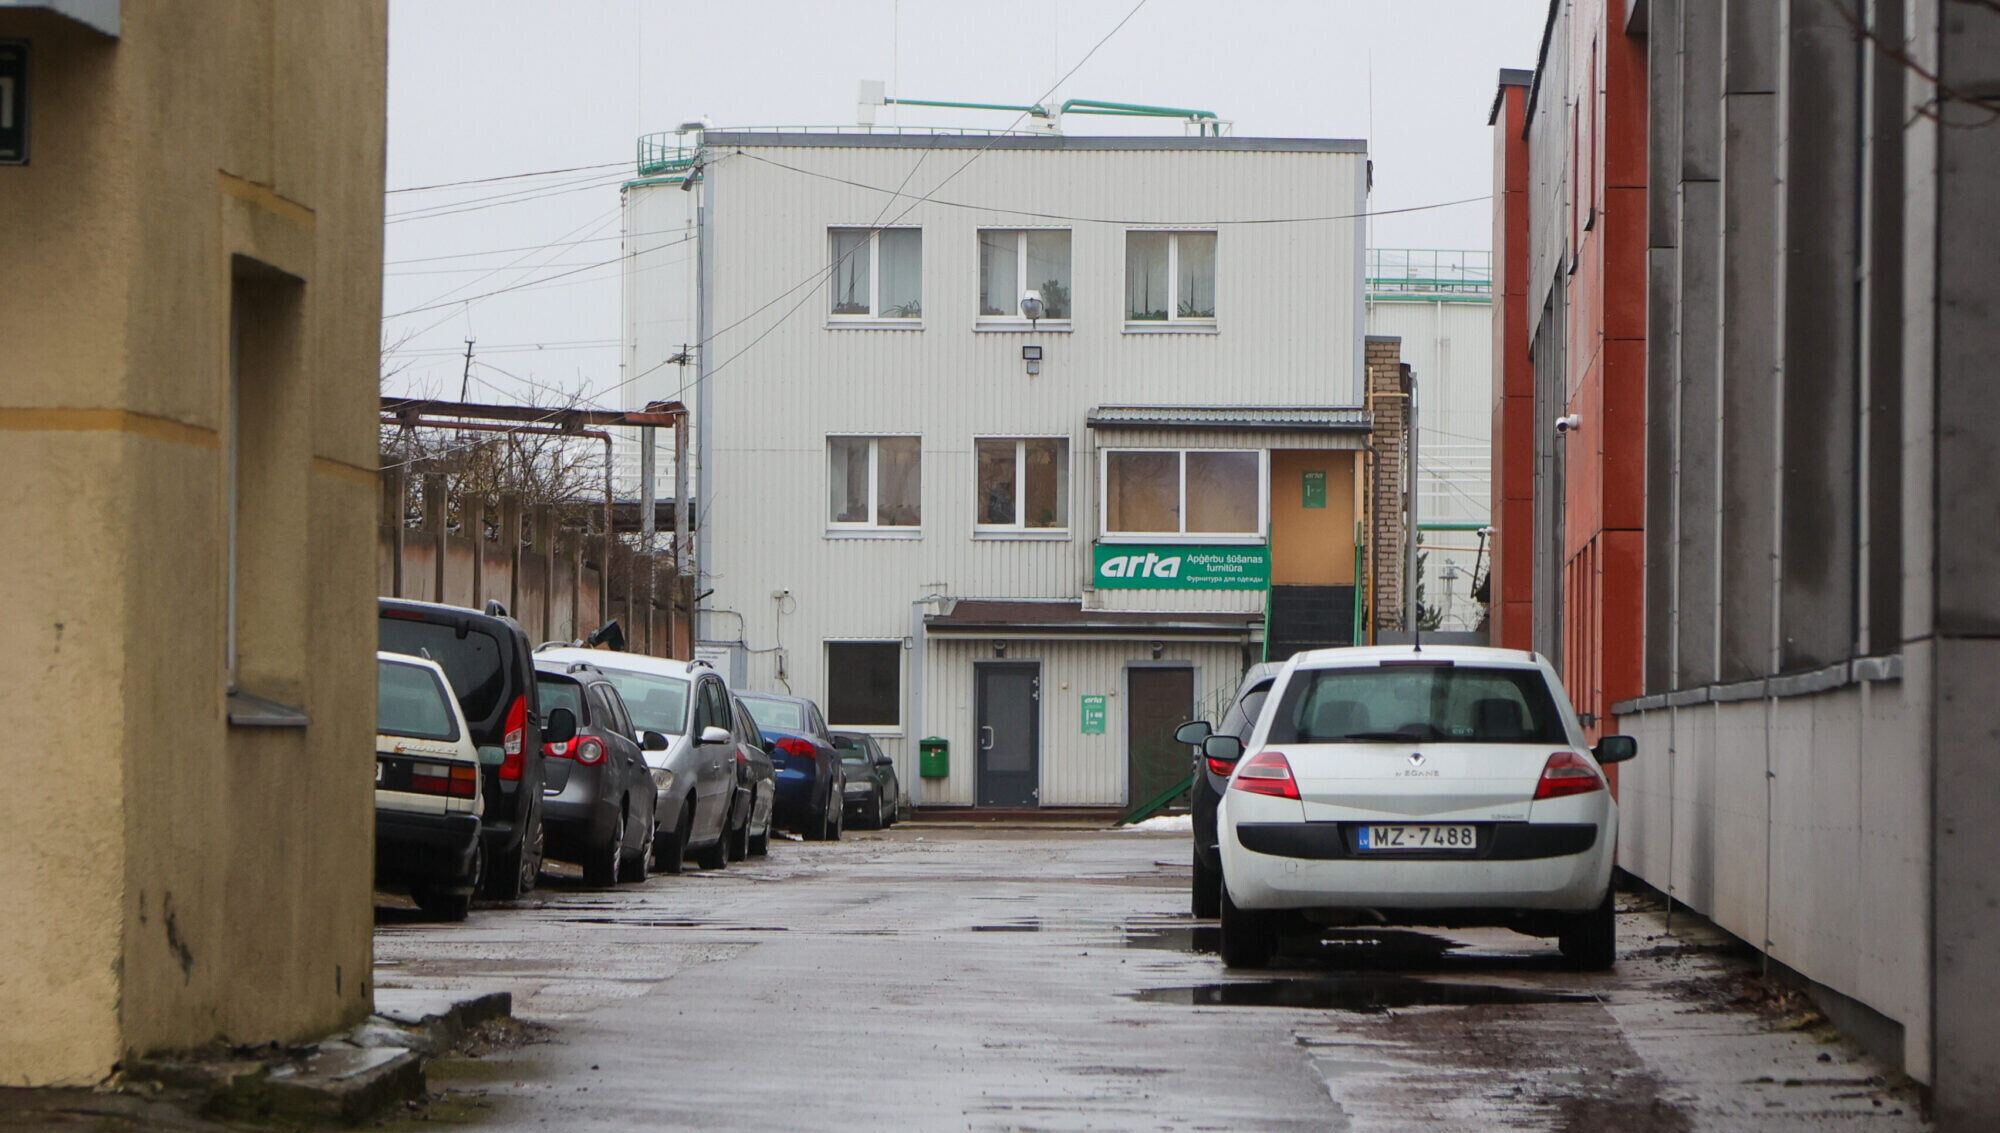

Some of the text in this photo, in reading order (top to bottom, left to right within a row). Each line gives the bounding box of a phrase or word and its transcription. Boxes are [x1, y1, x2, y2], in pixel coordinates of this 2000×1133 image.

[1100, 552, 1181, 578] arta
[1186, 553, 1224, 565] Apģērbu
[1186, 575, 1222, 584] Фурнитура
[1374, 827, 1472, 846] MZ-7488
